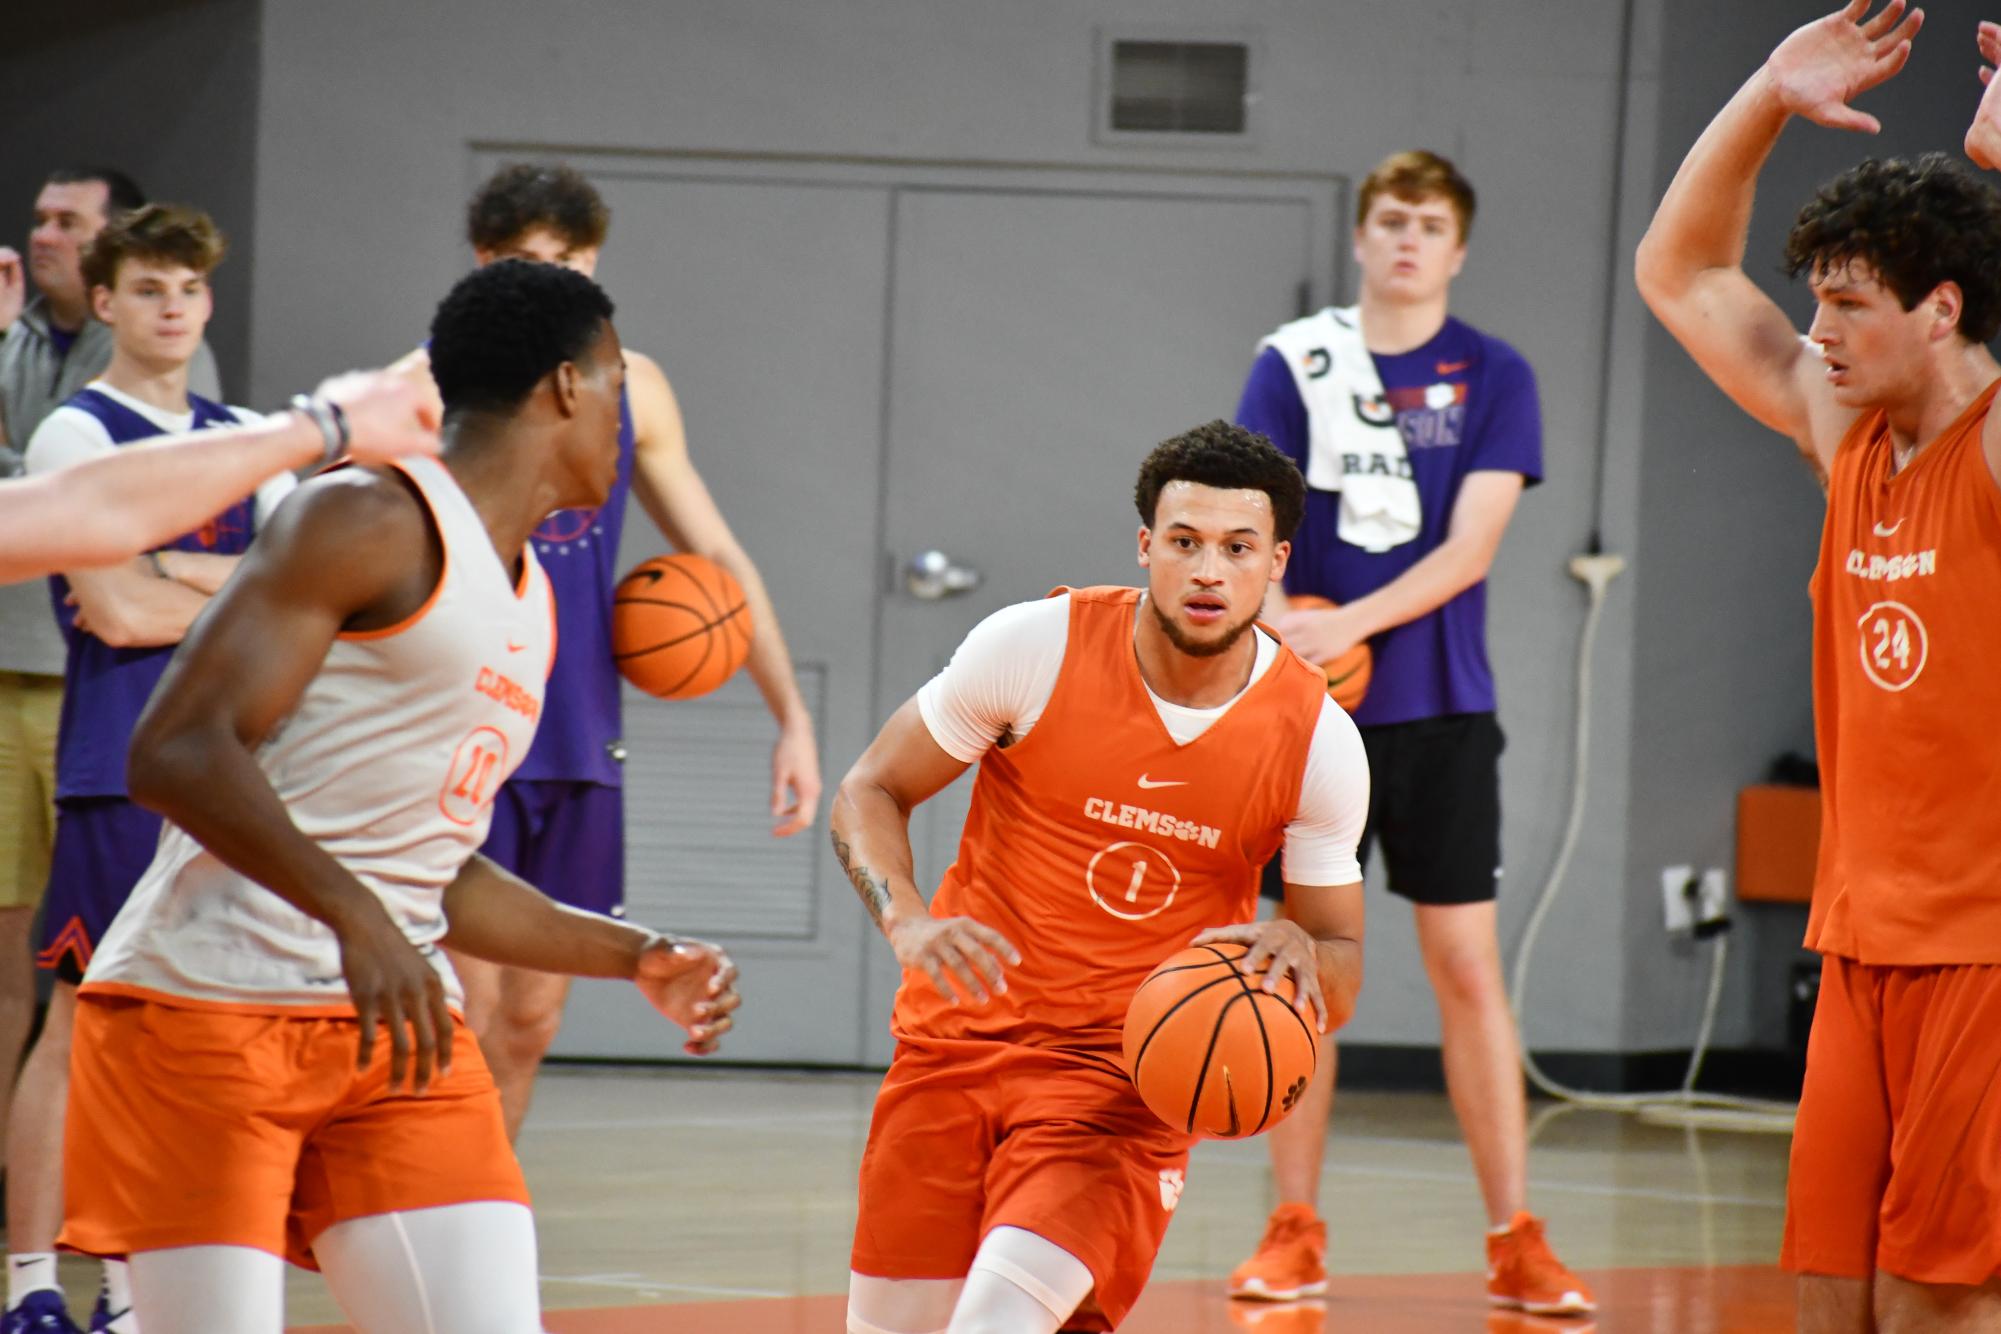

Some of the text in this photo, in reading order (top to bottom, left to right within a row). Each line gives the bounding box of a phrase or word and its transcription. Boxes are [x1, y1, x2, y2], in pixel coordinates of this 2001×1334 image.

[1873, 618, 1911, 669] 24
[1084, 797, 1222, 849] CLEMSON
[1125, 860, 1148, 902] 1
